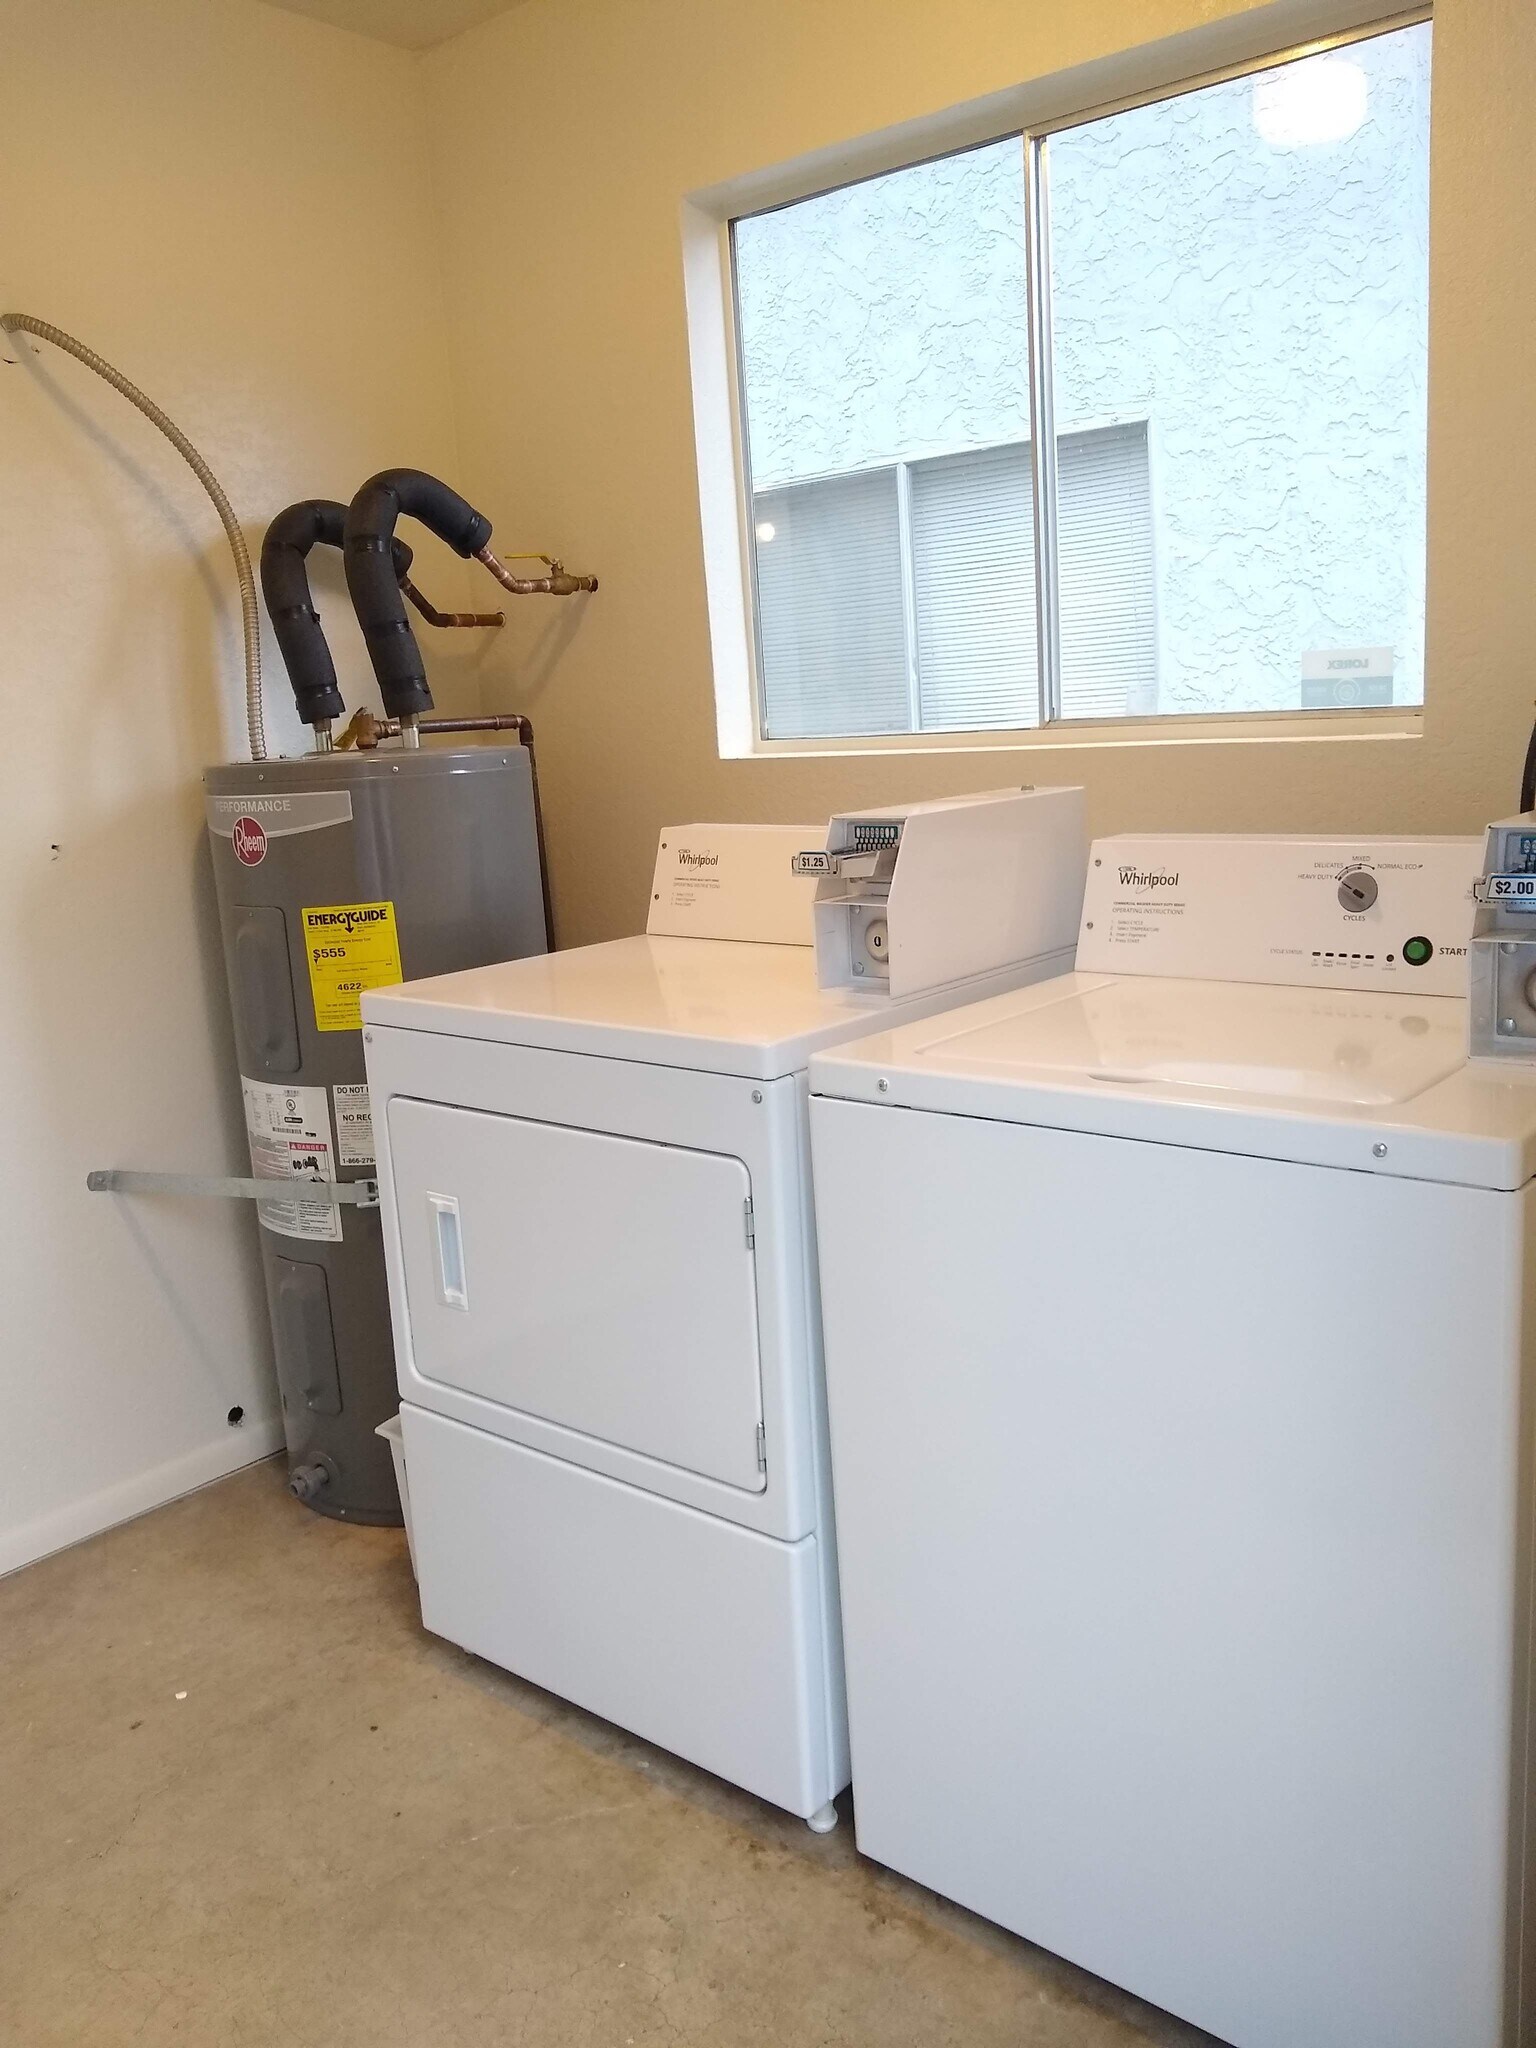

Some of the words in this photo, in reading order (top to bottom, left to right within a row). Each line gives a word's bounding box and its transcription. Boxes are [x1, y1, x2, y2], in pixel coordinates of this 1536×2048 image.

[232, 817, 267, 859] Rheem
[678, 853, 719, 868] Whirlpool
[801, 857, 824, 868] $1.25
[1119, 872, 1179, 889] Whirlpool
[1495, 880, 1534, 895] $2.00
[307, 908, 388, 927] ENERGYGUIDE
[312, 947, 347, 960] $555
[1439, 948, 1468, 956] START
[337, 982, 362, 991] 4622
[337, 1086, 348, 1094] DO
[349, 1086, 365, 1094] NOT
[342, 1113, 355, 1122] NO
[296, 1143, 326, 1151] DANGER
